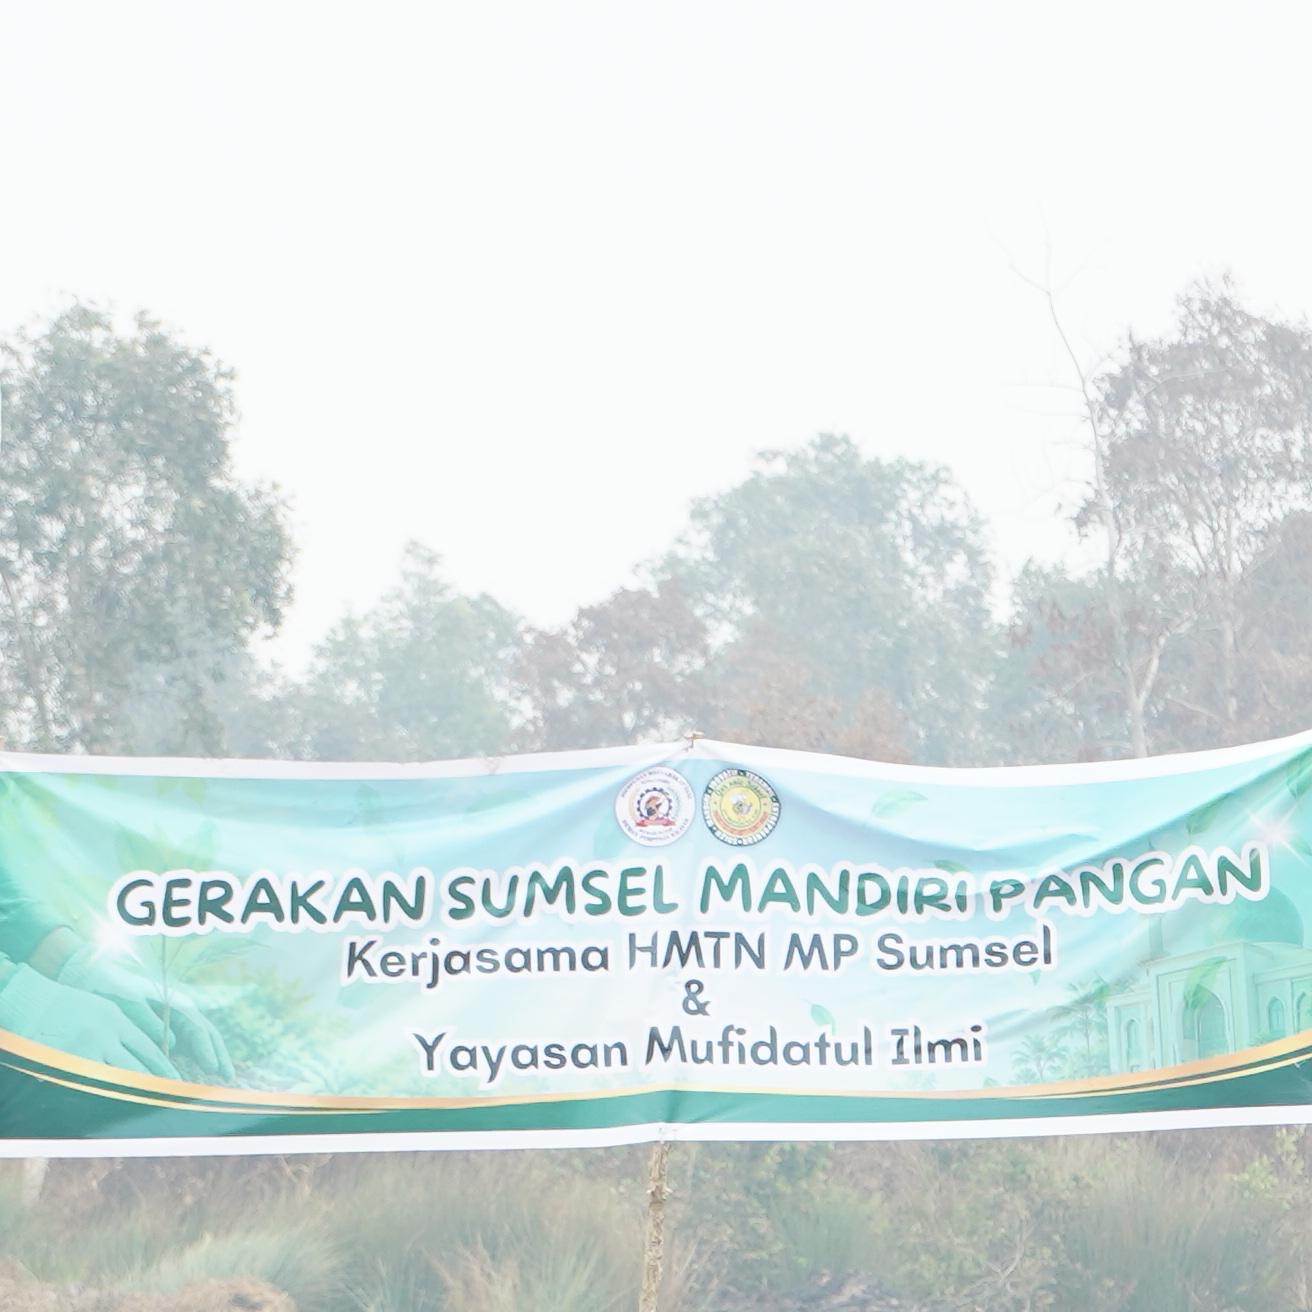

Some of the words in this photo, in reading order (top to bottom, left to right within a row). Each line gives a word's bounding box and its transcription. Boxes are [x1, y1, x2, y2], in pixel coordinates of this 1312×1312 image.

[116, 875, 426, 927] GERAKAN
[448, 864, 679, 921] SUMSEL
[700, 862, 968, 917] MANDIRI
[991, 847, 1262, 912] PANGAN
[347, 938, 609, 988] Kerjasama
[629, 929, 765, 971] HMTN
[784, 932, 858, 971] MP
[877, 924, 1052, 970] Sumsel
[682, 979, 710, 1016] &
[413, 1033, 627, 1083] Yayasan
[646, 1025, 872, 1066] Mufidatul
[891, 1024, 983, 1065] Ilmi
